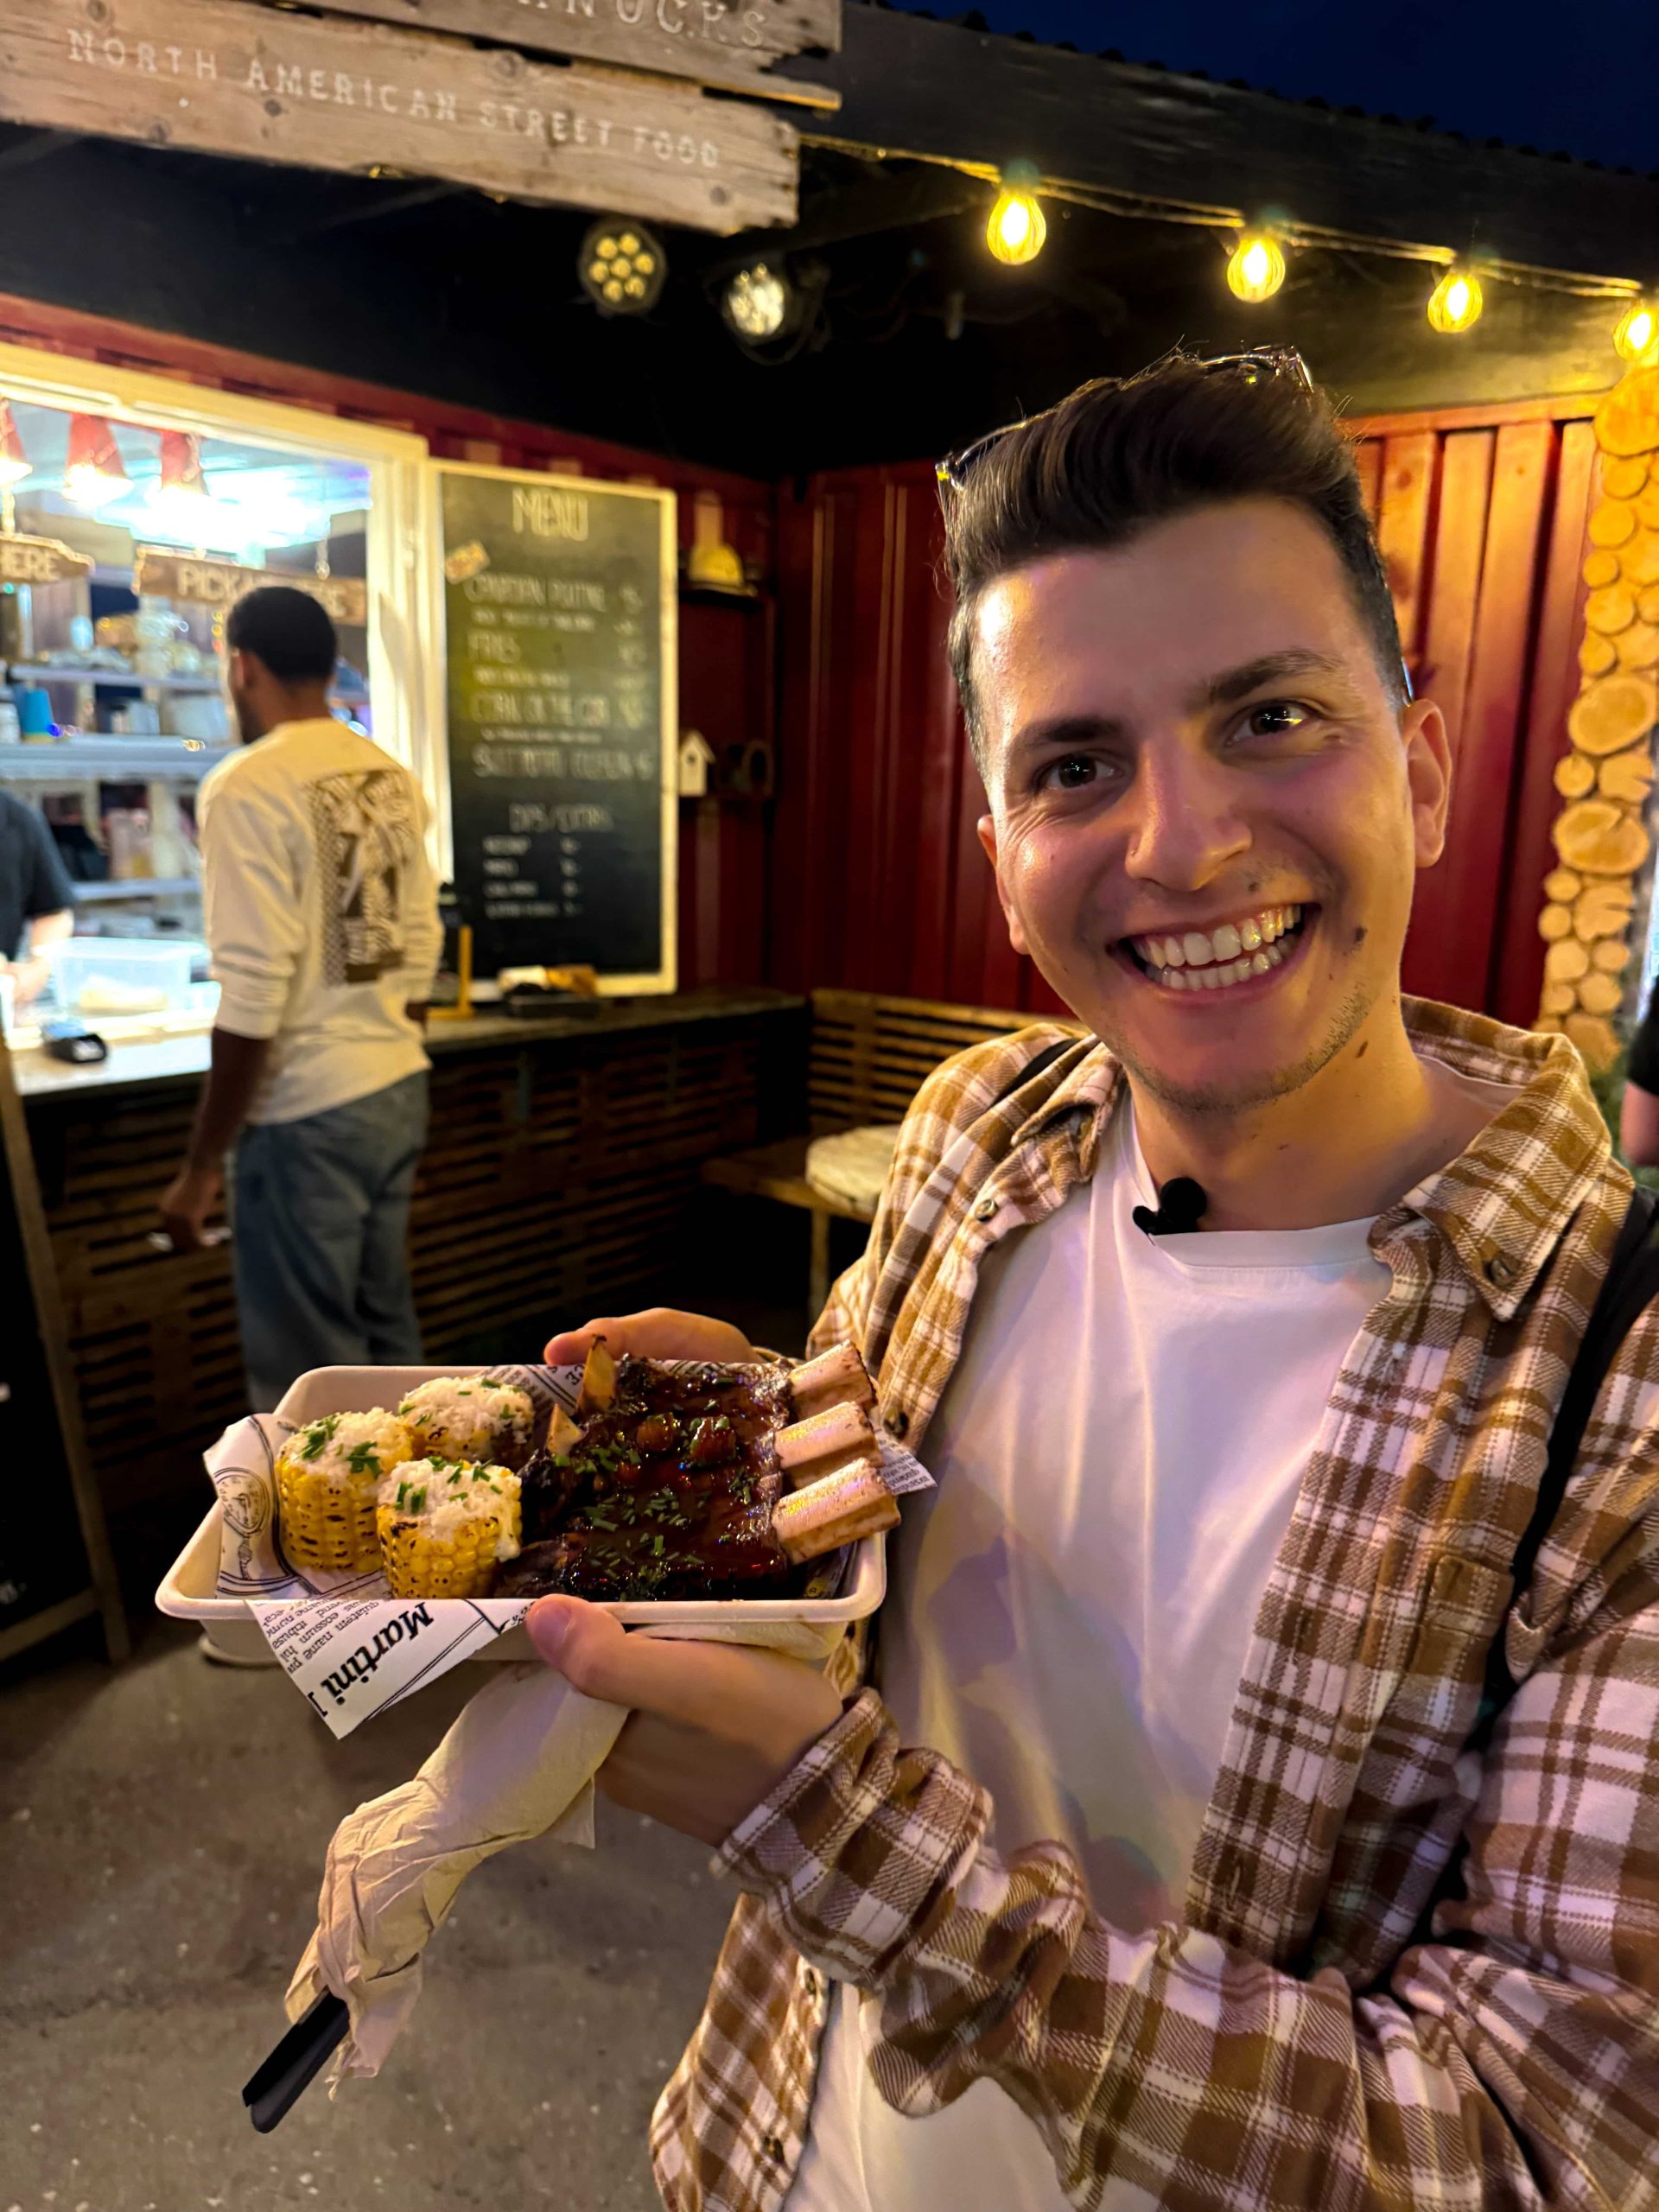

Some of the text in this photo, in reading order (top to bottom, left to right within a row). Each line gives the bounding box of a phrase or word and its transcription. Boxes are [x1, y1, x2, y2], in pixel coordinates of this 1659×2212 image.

[67, 28, 720, 168] NORTH AMERICAN STREET FOOD
[512, 486, 589, 542] MENU
[302, 1630, 334, 1660] name
[320, 1602, 435, 1706] Martini
